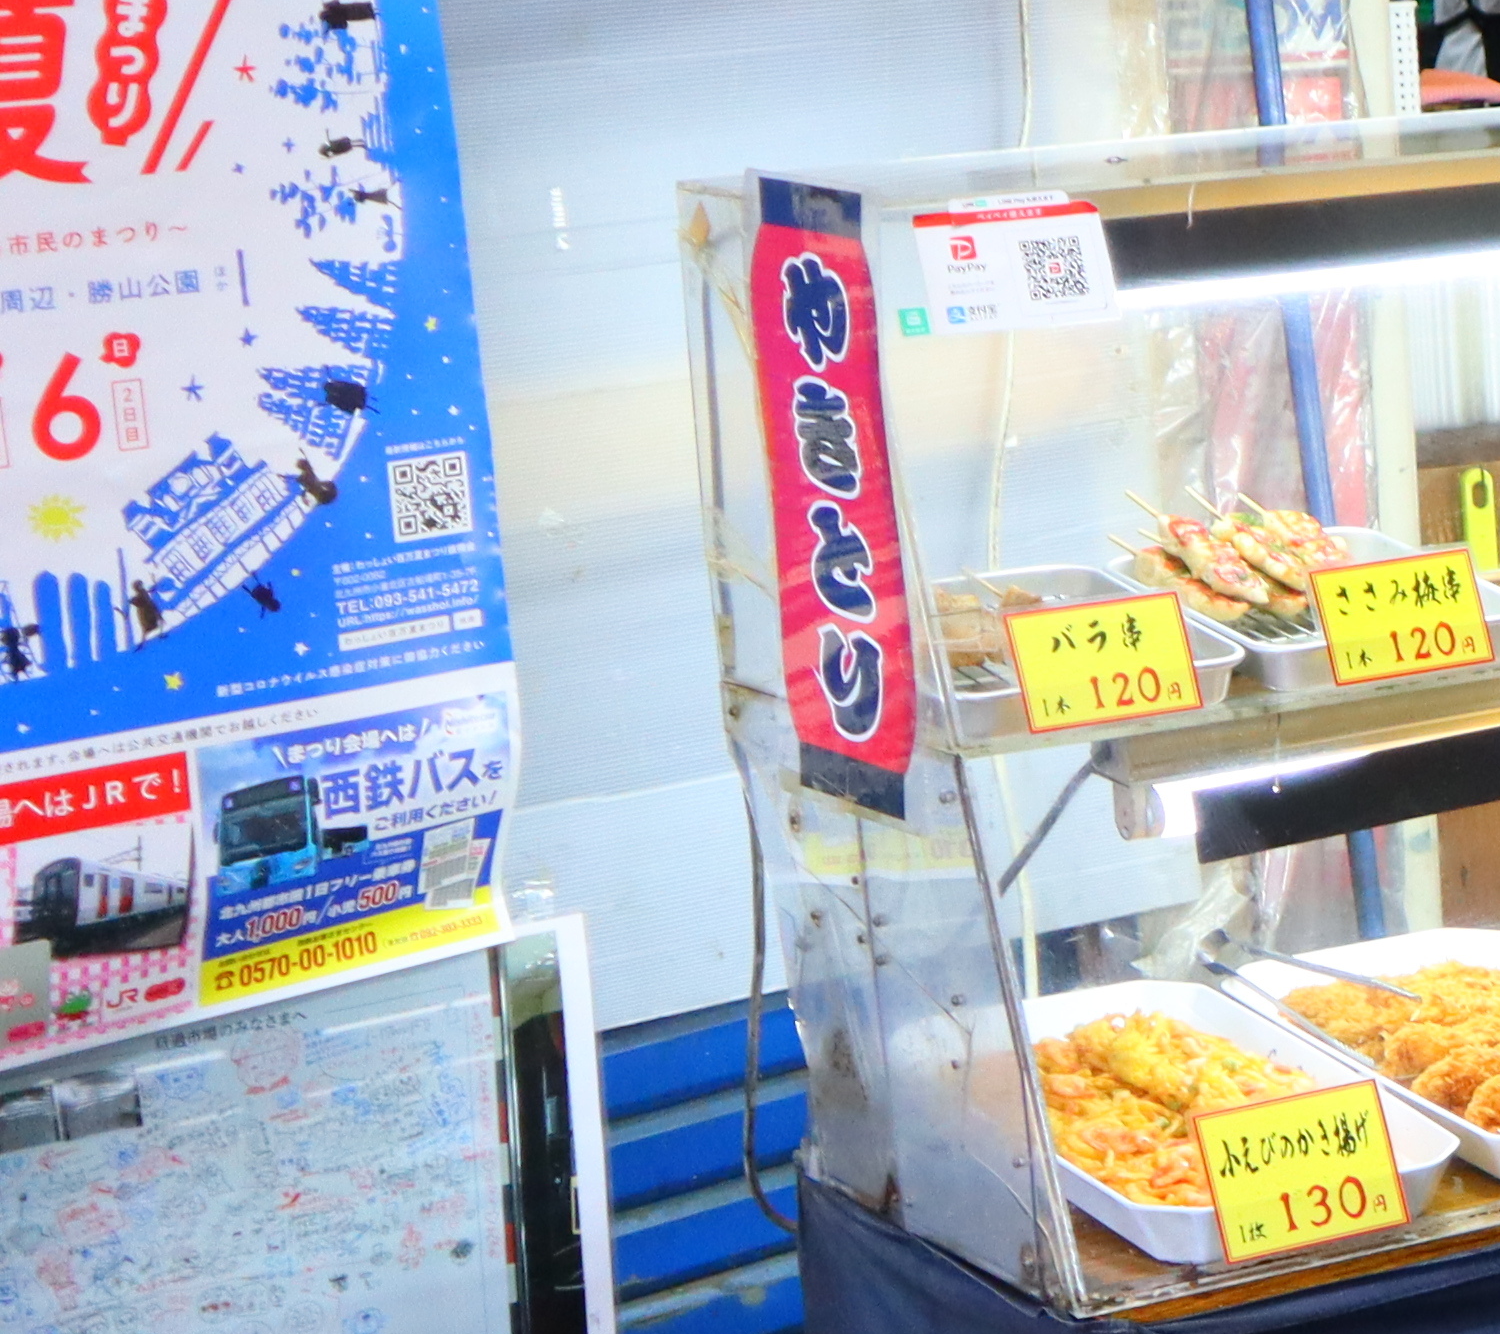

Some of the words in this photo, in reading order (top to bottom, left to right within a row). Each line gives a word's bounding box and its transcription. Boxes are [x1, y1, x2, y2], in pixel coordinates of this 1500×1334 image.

[948, 262, 987, 274] PayPay
[32, 350, 102, 462] 6
[782, 251, 884, 743] やきとり
[1334, 565, 1462, 617] ささみ梅串
[1050, 615, 1143, 653] バラ串
[1391, 620, 1475, 664] 120円
[1091, 665, 1183, 711] 120円
[286, 724, 418, 766] まつり会場へは
[239, 930, 378, 988] 0570-00-1010
[1219, 1109, 1369, 1178] 小えびのかき揚げ
[1279, 1174, 1388, 1233] 130円
